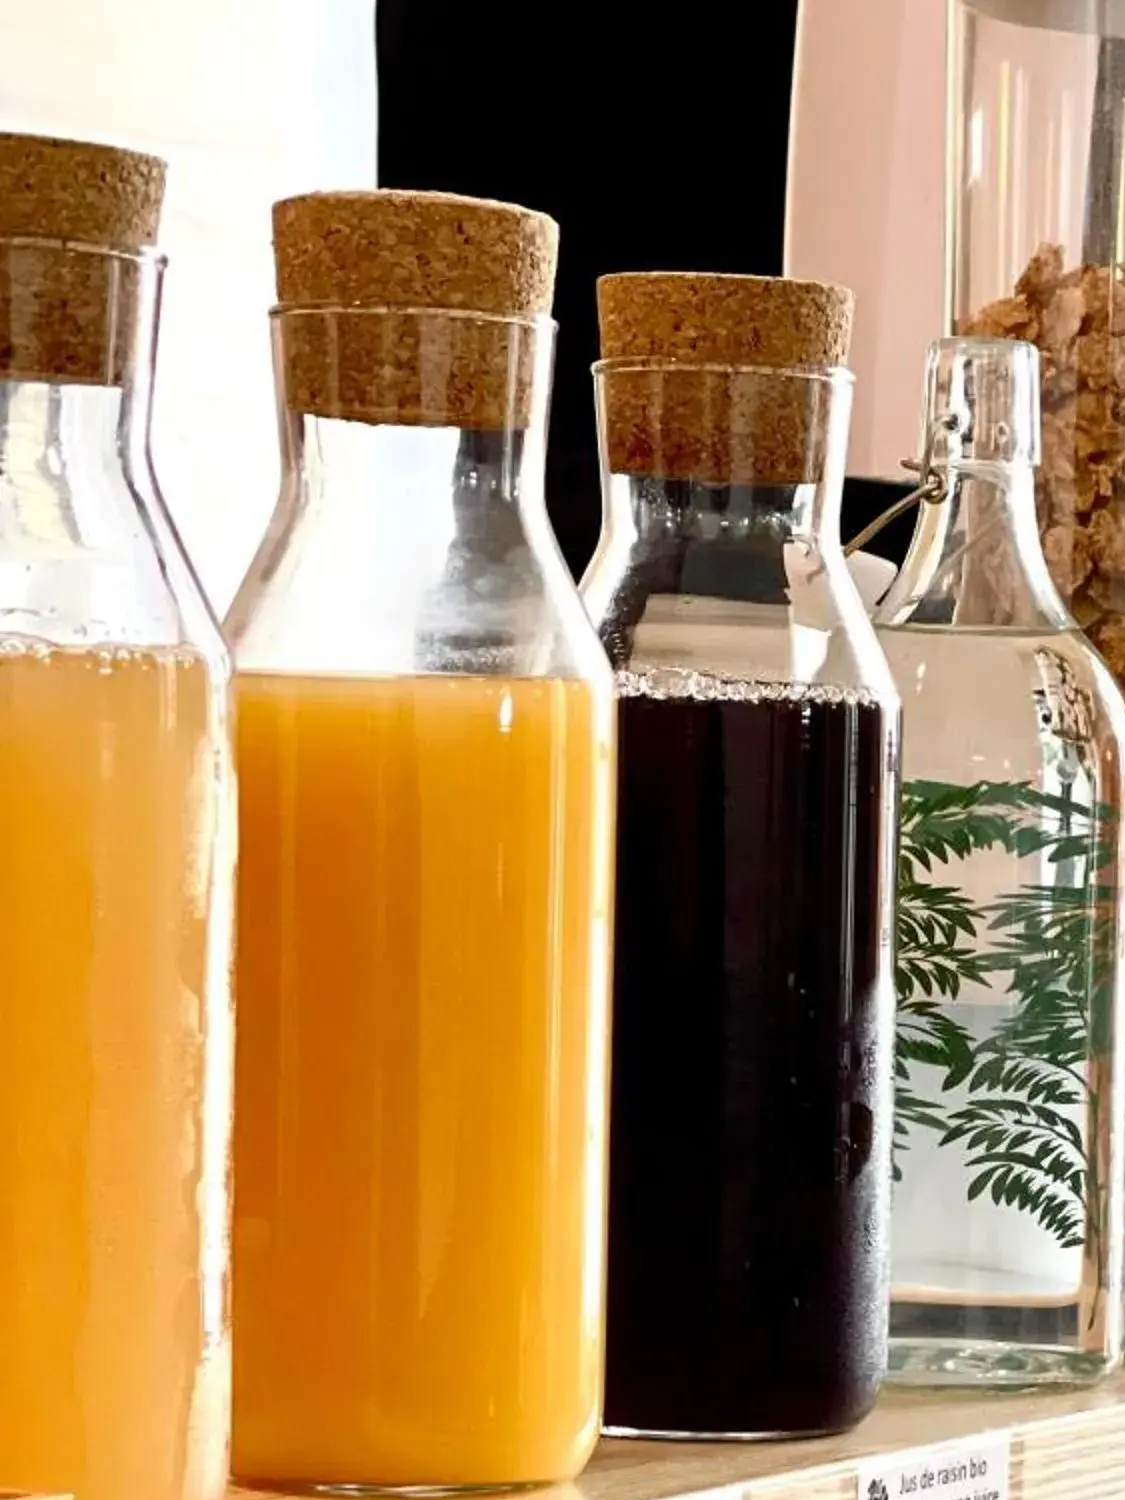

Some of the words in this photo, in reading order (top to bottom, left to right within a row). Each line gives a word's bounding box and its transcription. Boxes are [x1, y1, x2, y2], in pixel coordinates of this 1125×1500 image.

[899, 1472, 917, 1495] Jus
[919, 1465, 935, 1489] de
[937, 1460, 967, 1485] raisin
[969, 1457, 987, 1479] bio
